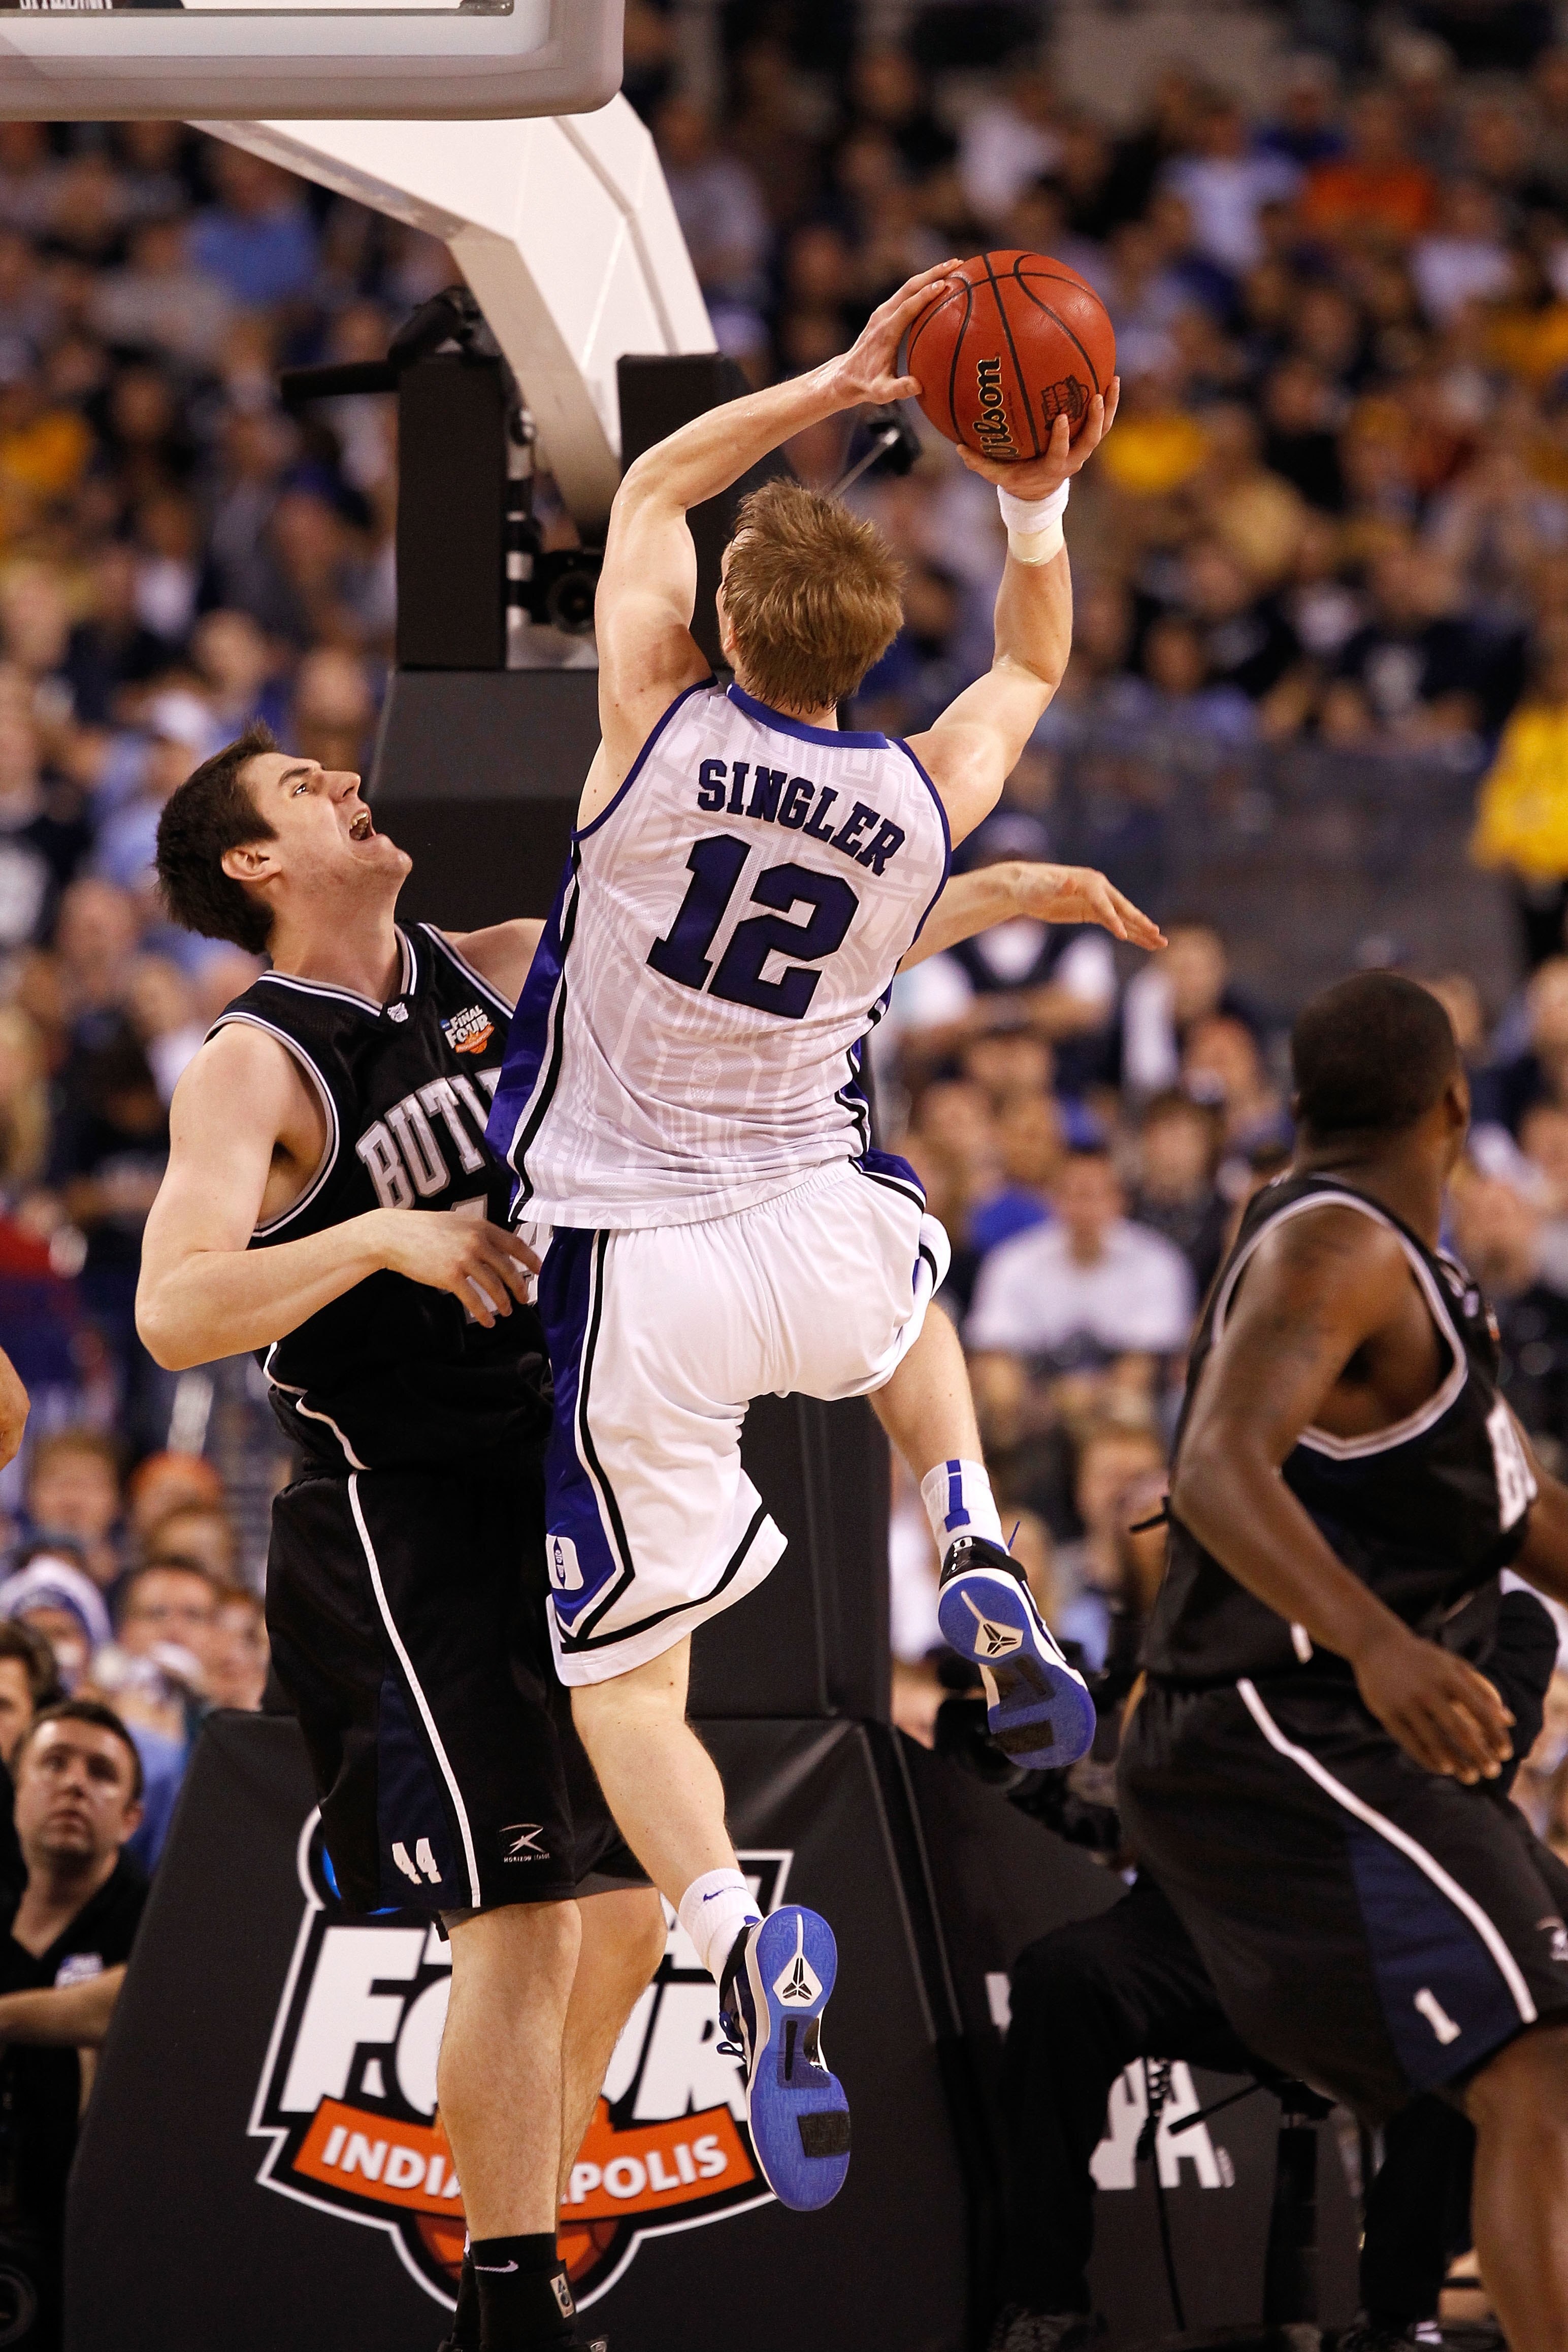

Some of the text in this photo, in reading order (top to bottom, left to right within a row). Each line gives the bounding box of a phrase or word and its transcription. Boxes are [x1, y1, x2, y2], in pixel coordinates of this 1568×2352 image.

[697, 759, 905, 876] SINGLER
[646, 834, 859, 1019] 12
[445, 1014, 492, 1049] FOUR
[450, 1004, 483, 1029] FINAL
[504, 1855, 532, 1863] HORIZON
[1414, 1987, 1462, 2044] 1
[321, 2126, 728, 2205] INDIPOLIS
